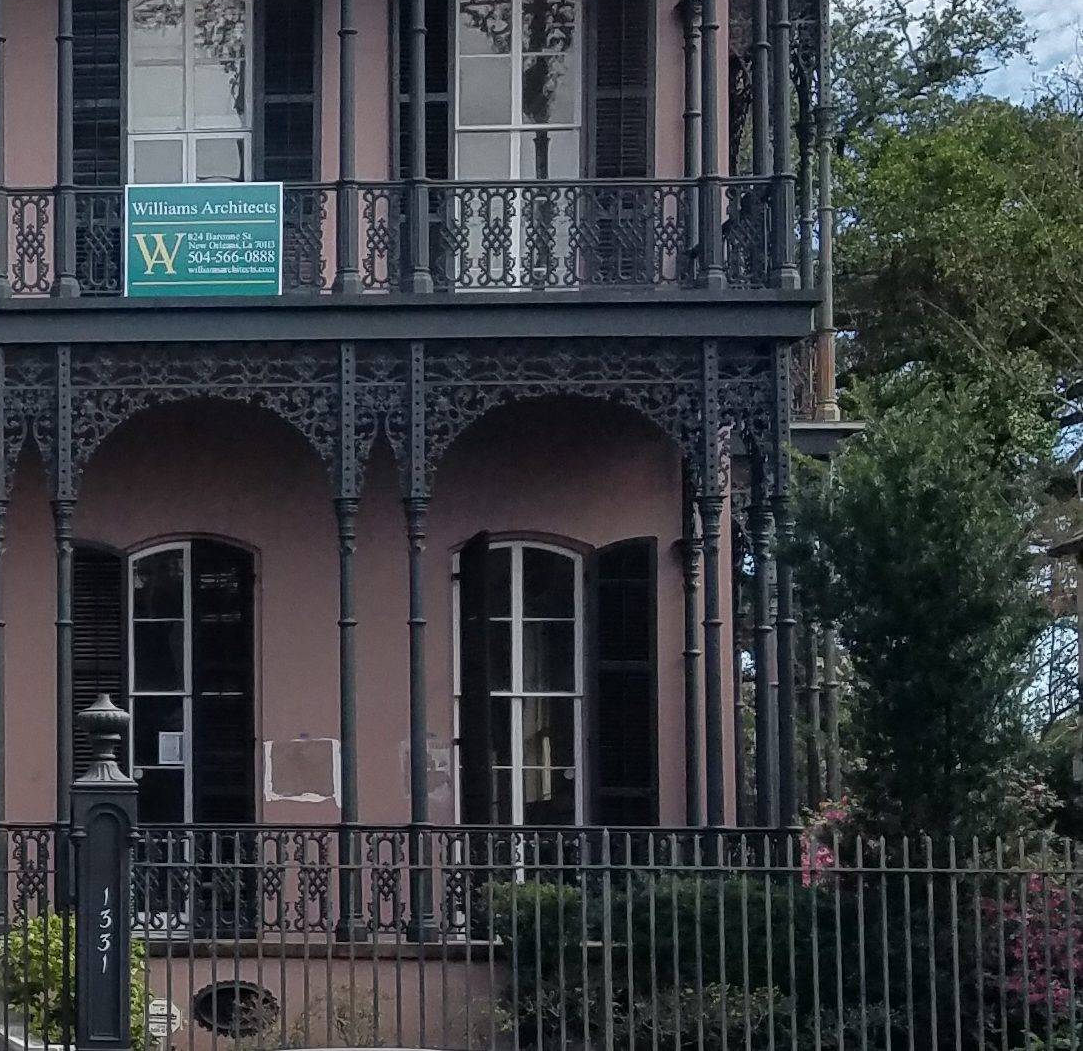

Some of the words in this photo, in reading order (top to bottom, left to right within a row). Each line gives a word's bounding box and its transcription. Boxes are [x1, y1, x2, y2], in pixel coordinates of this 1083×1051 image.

[132, 201, 198, 215] Williams
[201, 200, 277, 214] Architects
[188, 241, 207, 249] New
[187, 250, 275, 263] 504-566-0888
[187, 265, 276, 274] williamsarchitects.com
[97, 886, 112, 974] 1331
